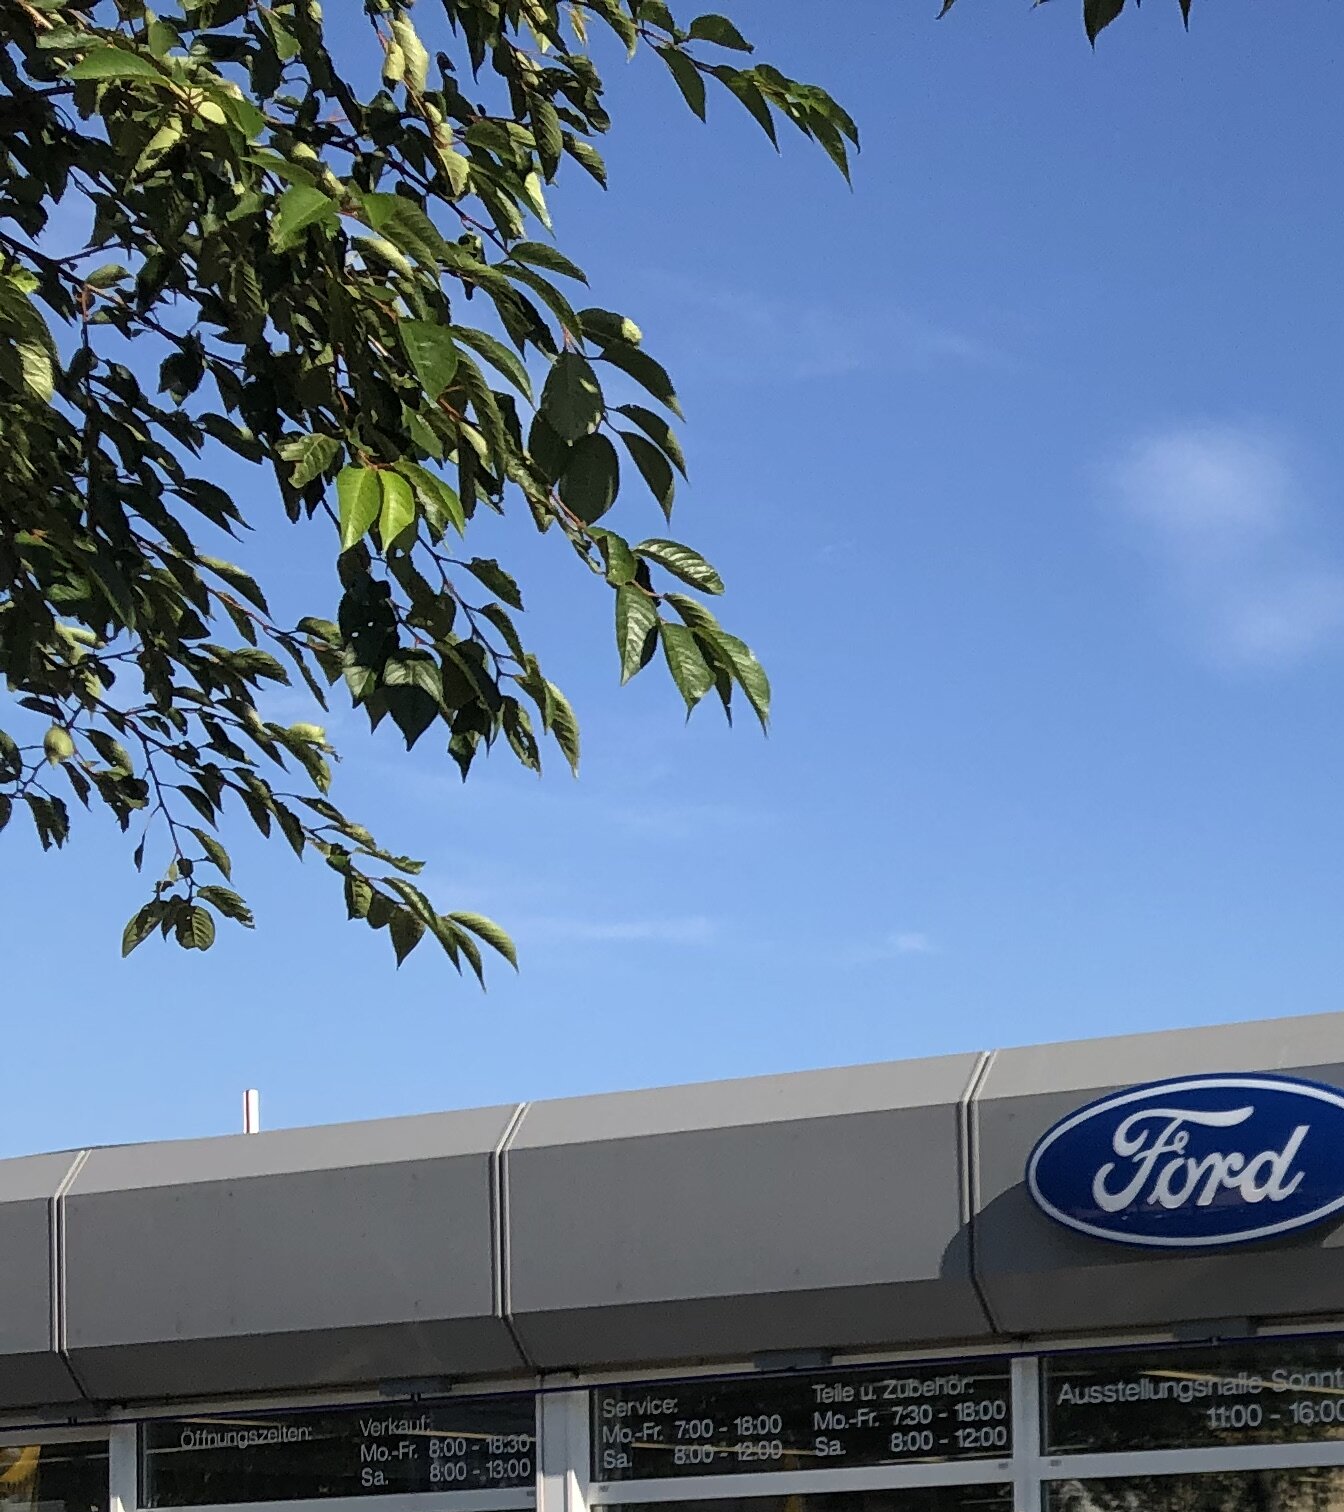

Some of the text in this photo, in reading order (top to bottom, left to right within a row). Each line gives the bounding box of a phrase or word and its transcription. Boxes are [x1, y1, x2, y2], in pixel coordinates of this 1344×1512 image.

[1092, 1105, 1311, 1213] Ford
[812, 1383, 854, 1403] Teile
[1056, 1372, 1262, 1405] Ausstellungshalle
[603, 1396, 679, 1418] Service:
[813, 1408, 879, 1431] Mo.-Fr.
[892, 1404, 933, 1426] 7:30
[954, 1400, 1007, 1422] 18:00
[1208, 1403, 1263, 1430] 11:00
[359, 1415, 431, 1437] Verkauf:
[602, 1422, 664, 1443] Mo.-Fr.
[674, 1419, 714, 1439] 7:00
[733, 1414, 783, 1436] 18:00
[360, 1442, 419, 1463] Mo.-Fr.
[428, 1438, 467, 1458] 8:00
[486, 1434, 530, 1455] 18:30
[815, 1436, 847, 1456] Sa.
[891, 1430, 934, 1452] 8:00
[954, 1426, 1007, 1448] 12:00
[603, 1450, 633, 1469] Sa.
[674, 1445, 714, 1465] 8:00
[361, 1467, 389, 1487] Sa.
[429, 1461, 467, 1482] 8:00
[486, 1457, 531, 1478] 13:00
